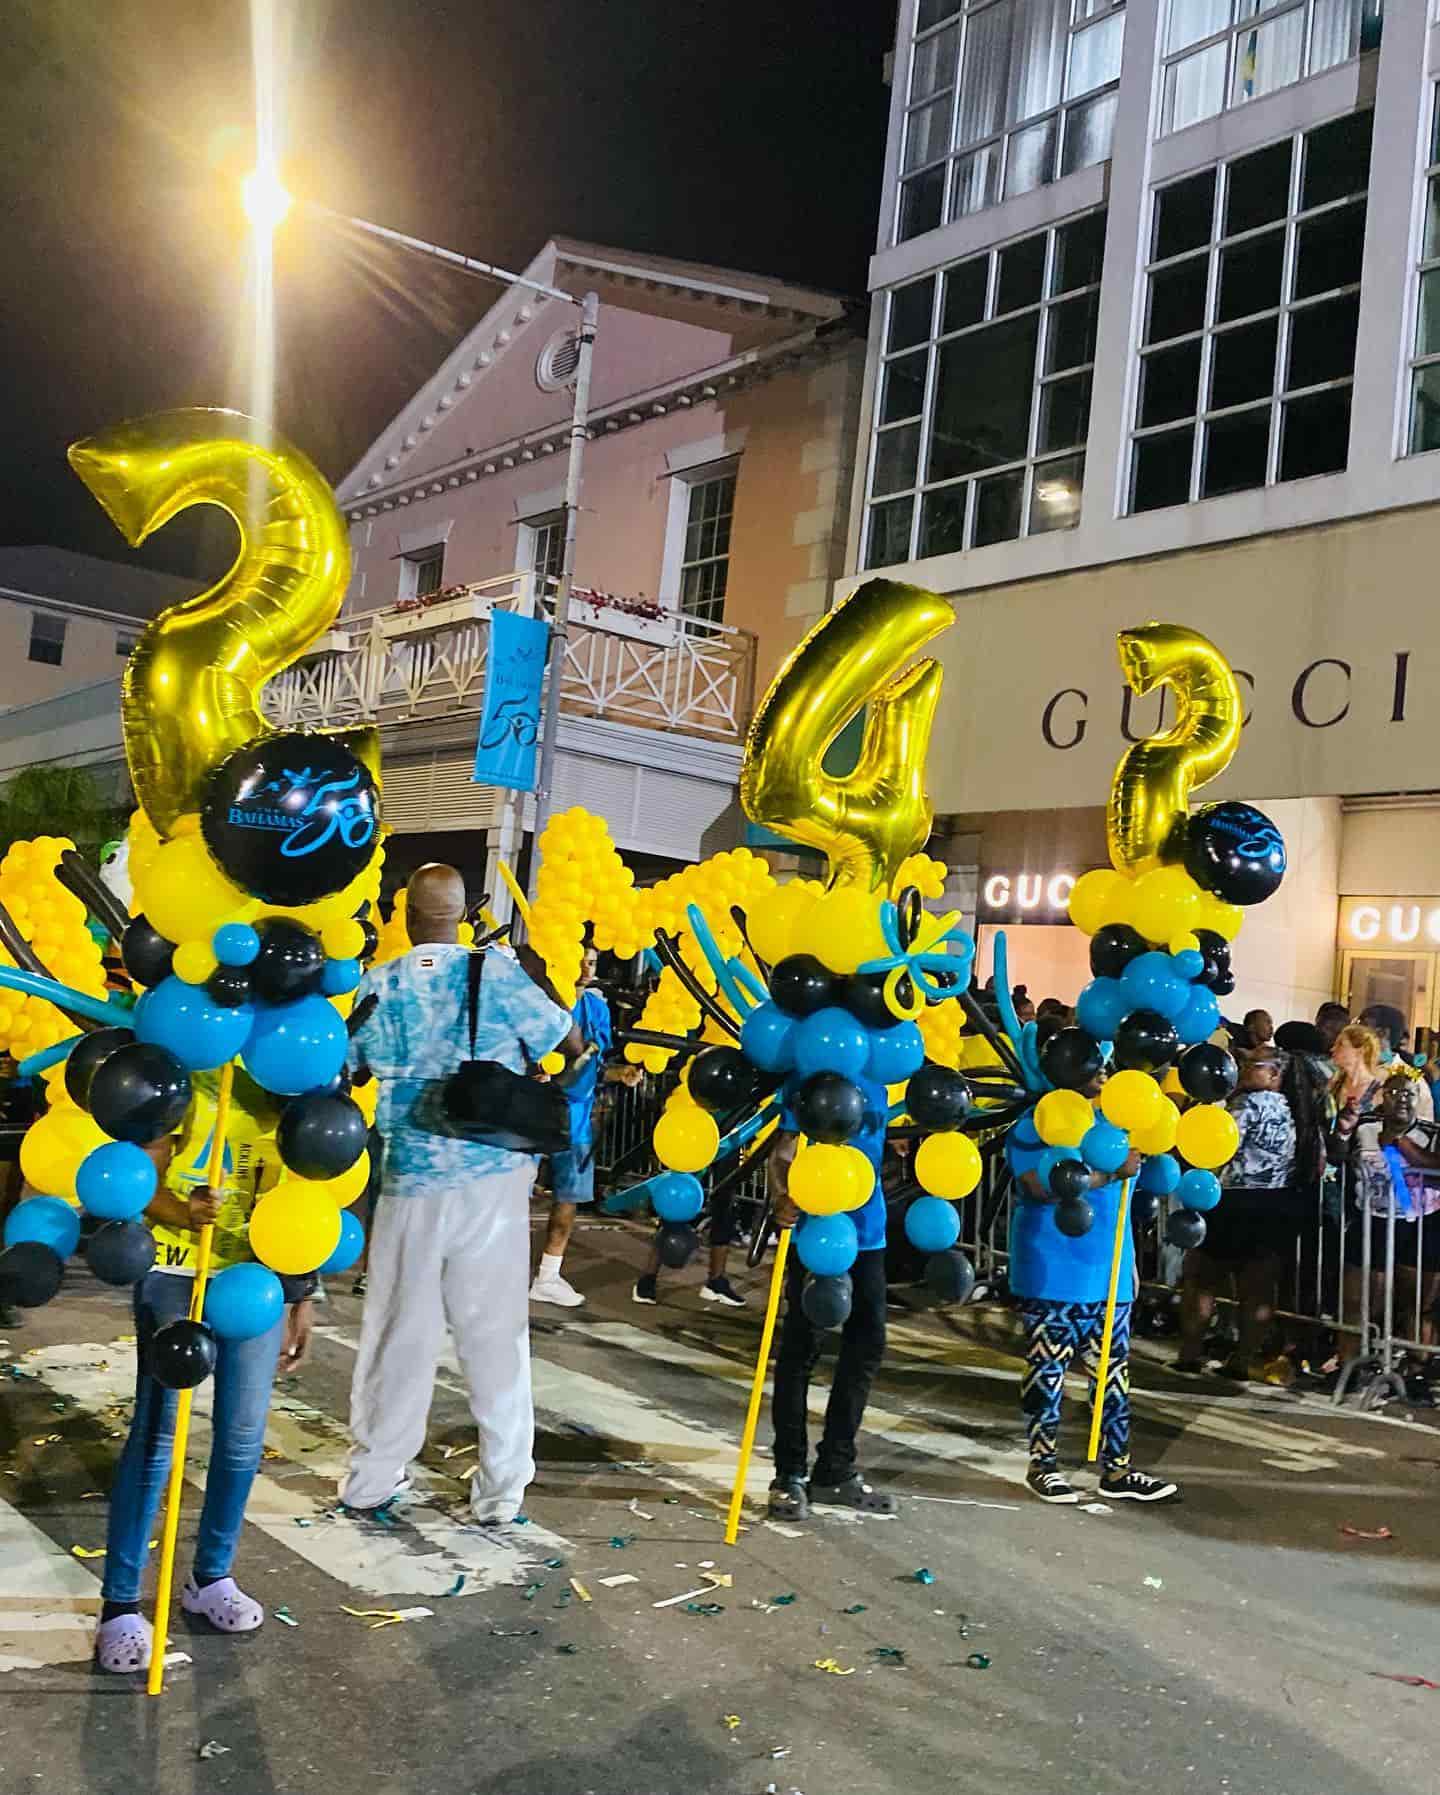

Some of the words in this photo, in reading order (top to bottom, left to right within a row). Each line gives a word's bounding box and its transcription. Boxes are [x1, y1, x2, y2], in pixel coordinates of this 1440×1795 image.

[68, 406, 380, 843] 2
[479, 692, 538, 750] 50
[740, 577, 956, 896] 4
[1106, 622, 1242, 879] 2
[228, 806, 305, 829] BAHAMAS
[280, 766, 375, 857] 50
[984, 873, 1077, 908] GUC
